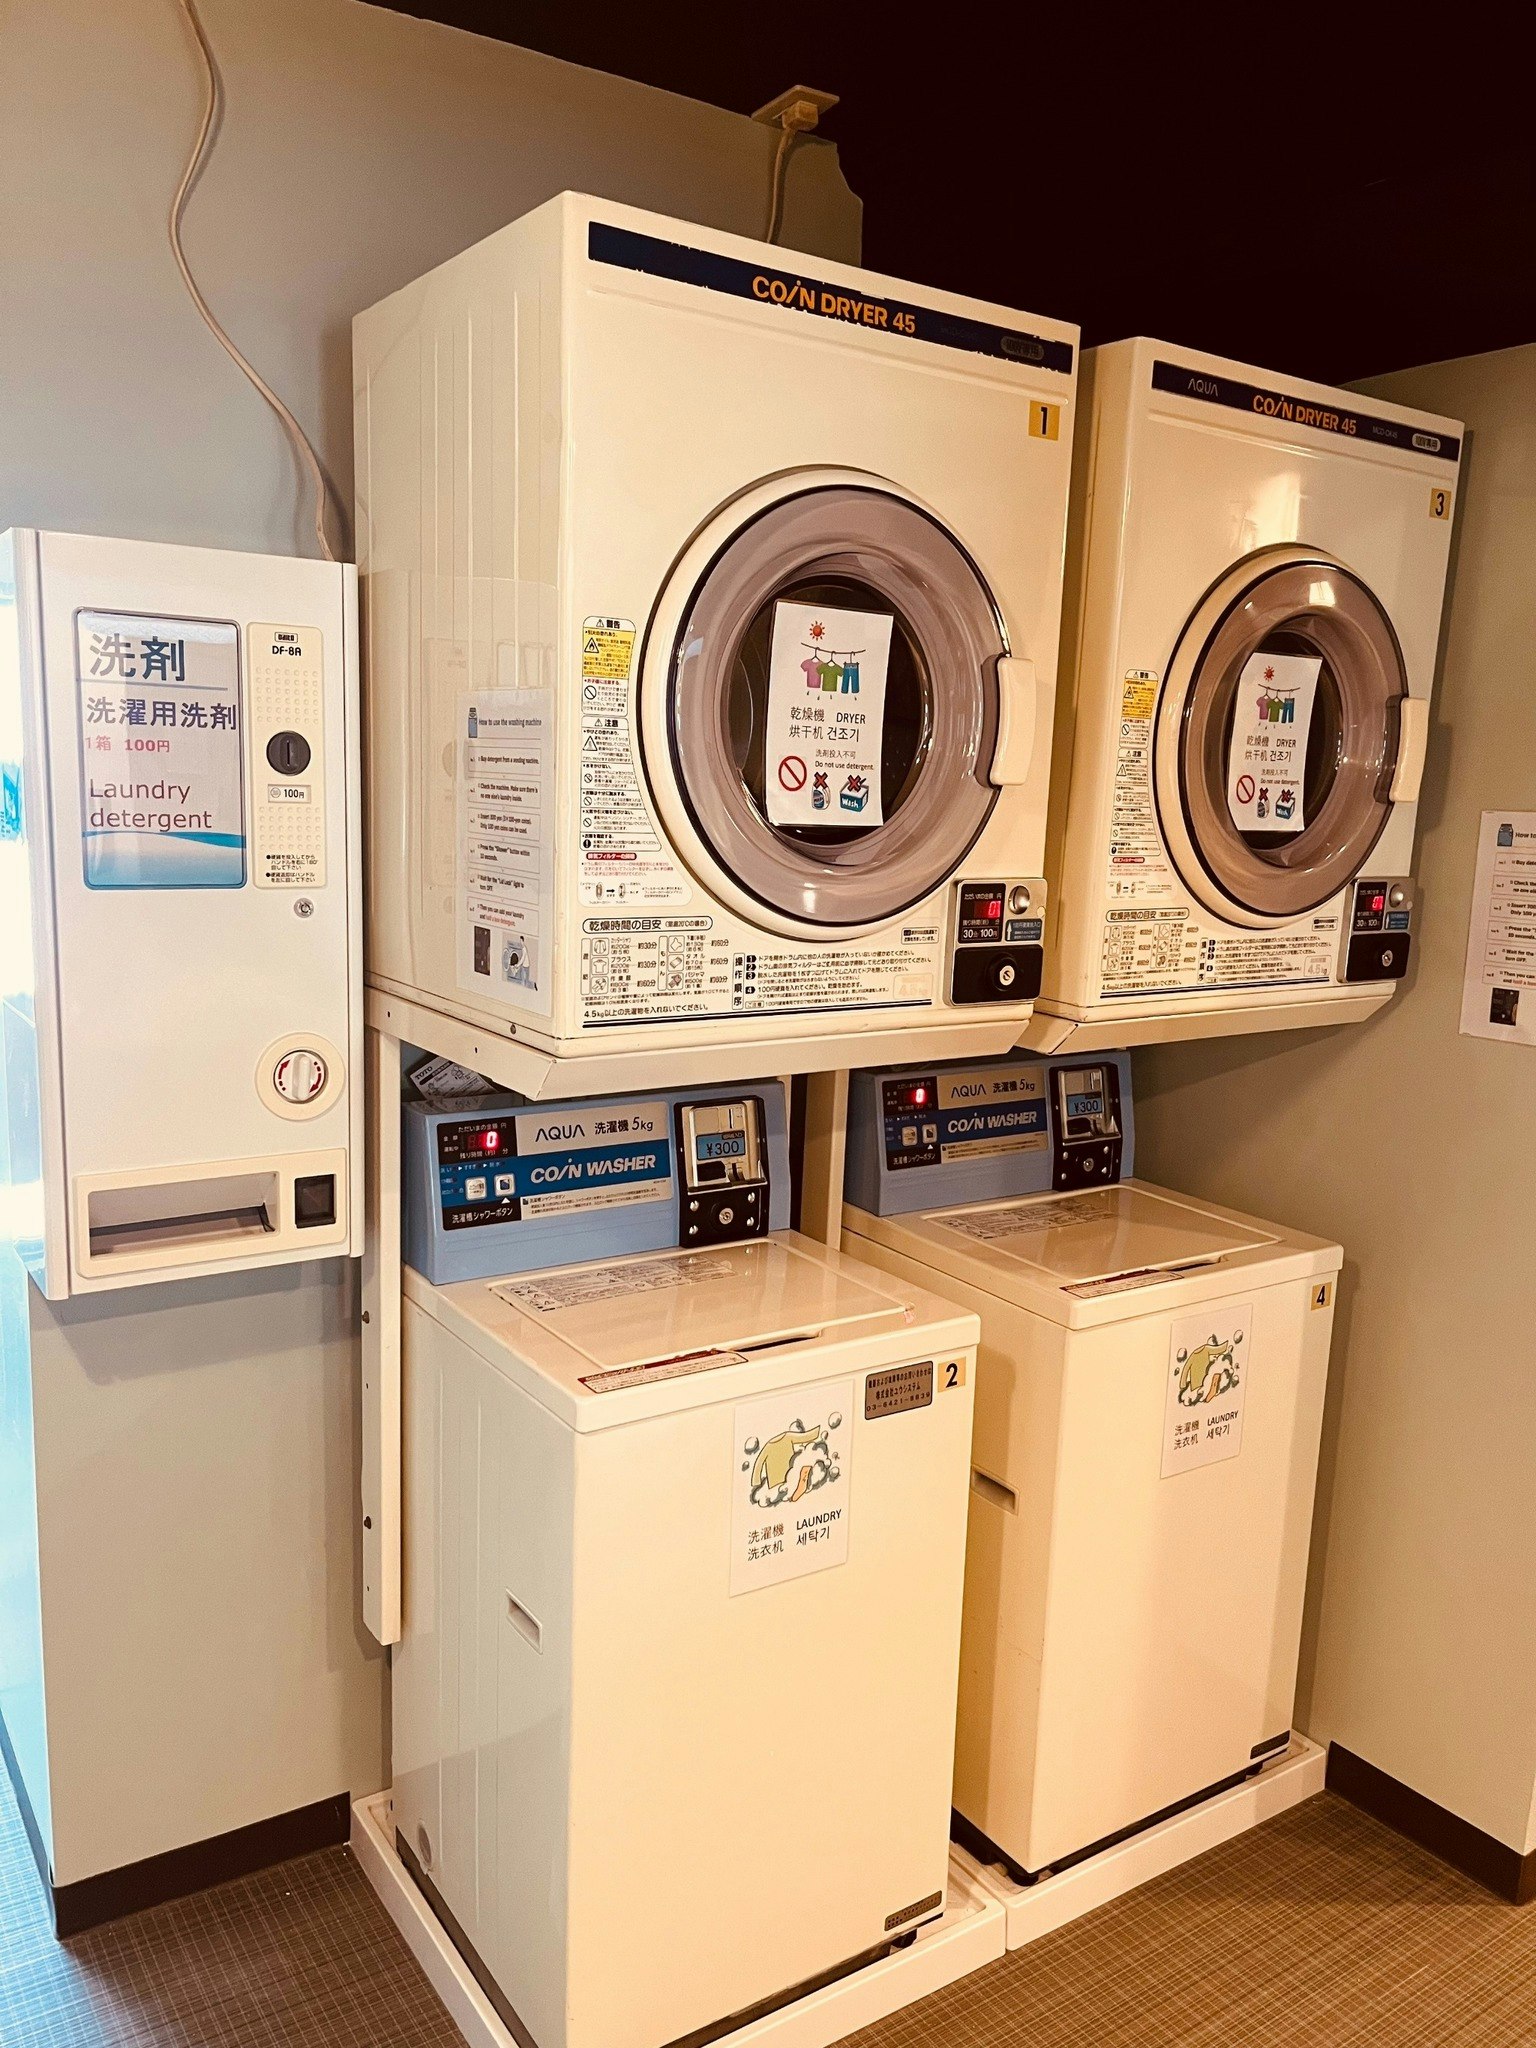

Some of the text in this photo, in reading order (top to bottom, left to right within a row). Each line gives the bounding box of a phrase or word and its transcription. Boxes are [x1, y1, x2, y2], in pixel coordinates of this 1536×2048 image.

[821, 292, 888, 328] DRYER
[893, 312, 916, 334] 45
[1188, 378, 1218, 398] AQUA
[1295, 406, 1339, 431] DRYER
[1341, 419, 1357, 435] 45
[1040, 406, 1048, 435] 1
[1435, 492, 1444, 516] 3
[89, 632, 186, 682] 洗剤
[272, 645, 302, 656] DF-8A
[86, 697, 237, 730] 洗濯用洗剤
[790, 707, 866, 725] 乾燥機 DRYER
[789, 725, 860, 742] 烘干机 건조기
[1276, 738, 1297, 748] DRYER
[124, 739, 170, 753] 100円
[1269, 750, 1292, 762] 건조기
[815, 760, 824, 768] Do
[824, 761, 834, 769] not
[89, 779, 191, 804] Laundry
[284, 789, 304, 798] 100円
[90, 808, 212, 832] detergent
[589, 919, 662, 931] 乾燥時間の目安
[414, 1066, 433, 1080] TOTO
[951, 1079, 1035, 1099] AQUA 洗濯機 5kg
[1074, 1100, 1098, 1113] ¥300
[535, 1116, 653, 1142] AQUA 洗濯機 5kg
[987, 1110, 1037, 1129] WASHER
[486, 1131, 498, 1148] 0
[706, 1141, 739, 1157] ¥300
[586, 1154, 656, 1176] WASHER
[1316, 1285, 1325, 1305] 4
[945, 1363, 958, 1388] 2
[1207, 1410, 1239, 1427] LAUNDRY
[1206, 1423, 1230, 1439] 세탁기
[796, 1509, 842, 1530] LAUNDRY
[748, 1523, 784, 1544] 洗濯機
[796, 1526, 830, 1546] 세탁기
[748, 1540, 784, 1561] 洗衣机
